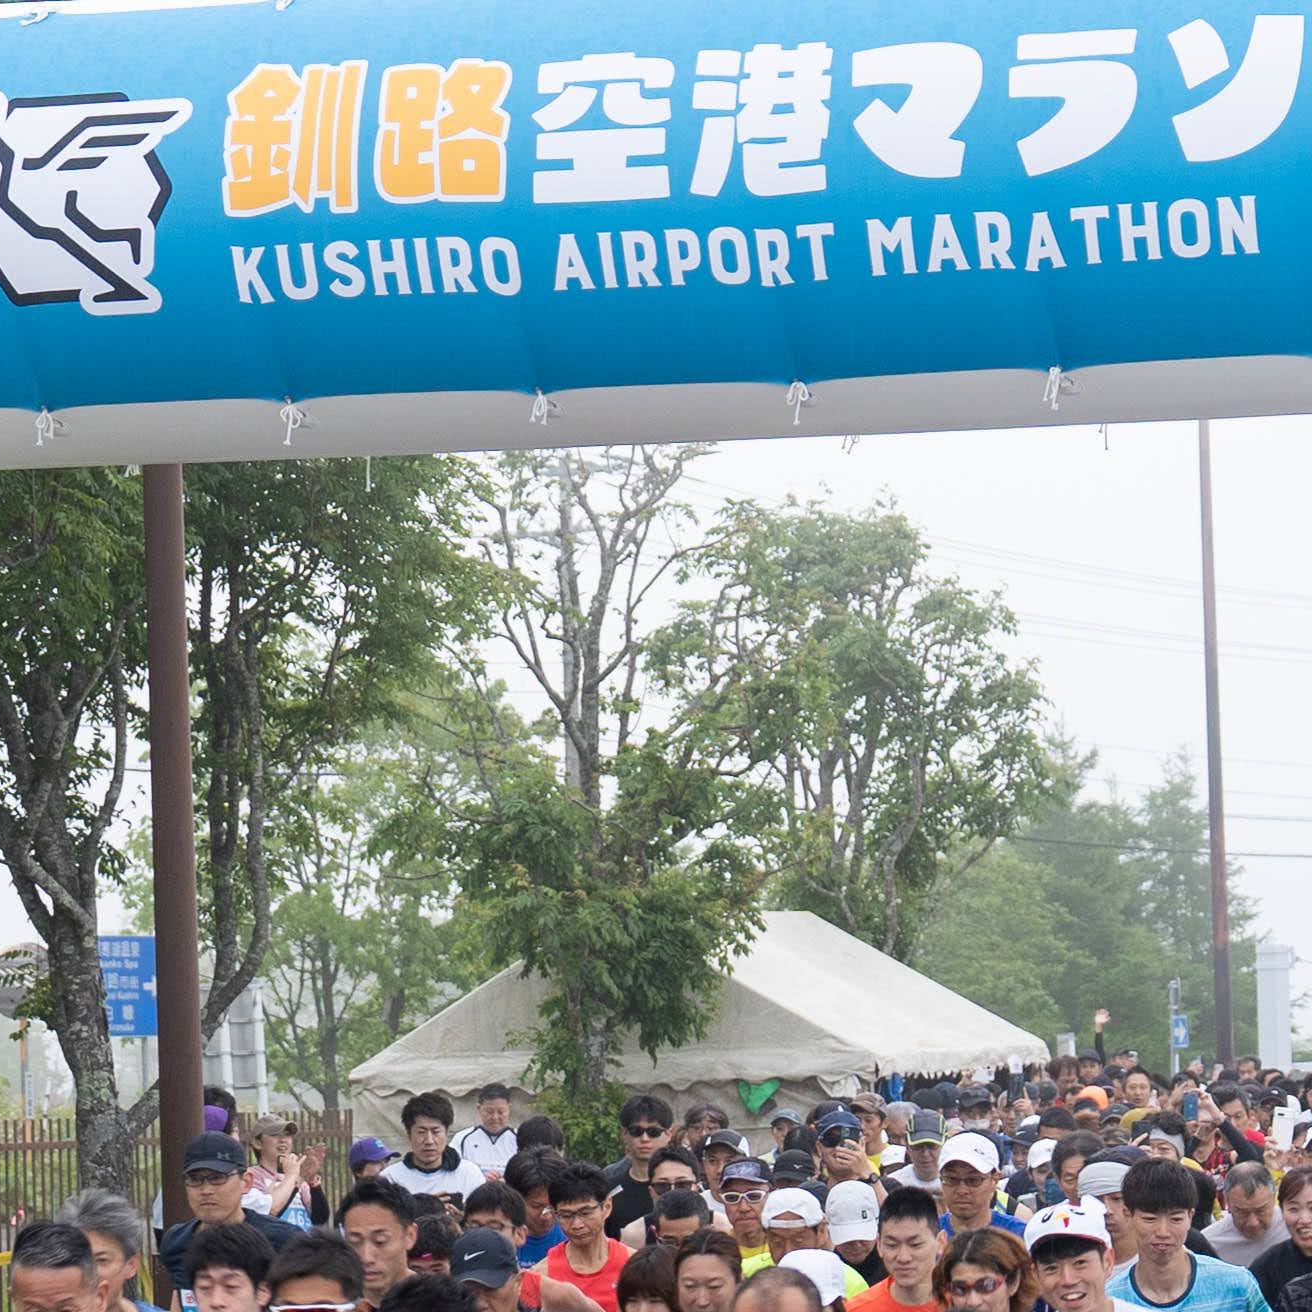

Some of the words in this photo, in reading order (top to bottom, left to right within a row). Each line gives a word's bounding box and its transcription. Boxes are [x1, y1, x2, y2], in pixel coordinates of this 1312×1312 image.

[229, 235, 522, 305] KUSHIRO
[554, 222, 835, 291] AIRPORT
[865, 195, 1261, 277] MARATHON
